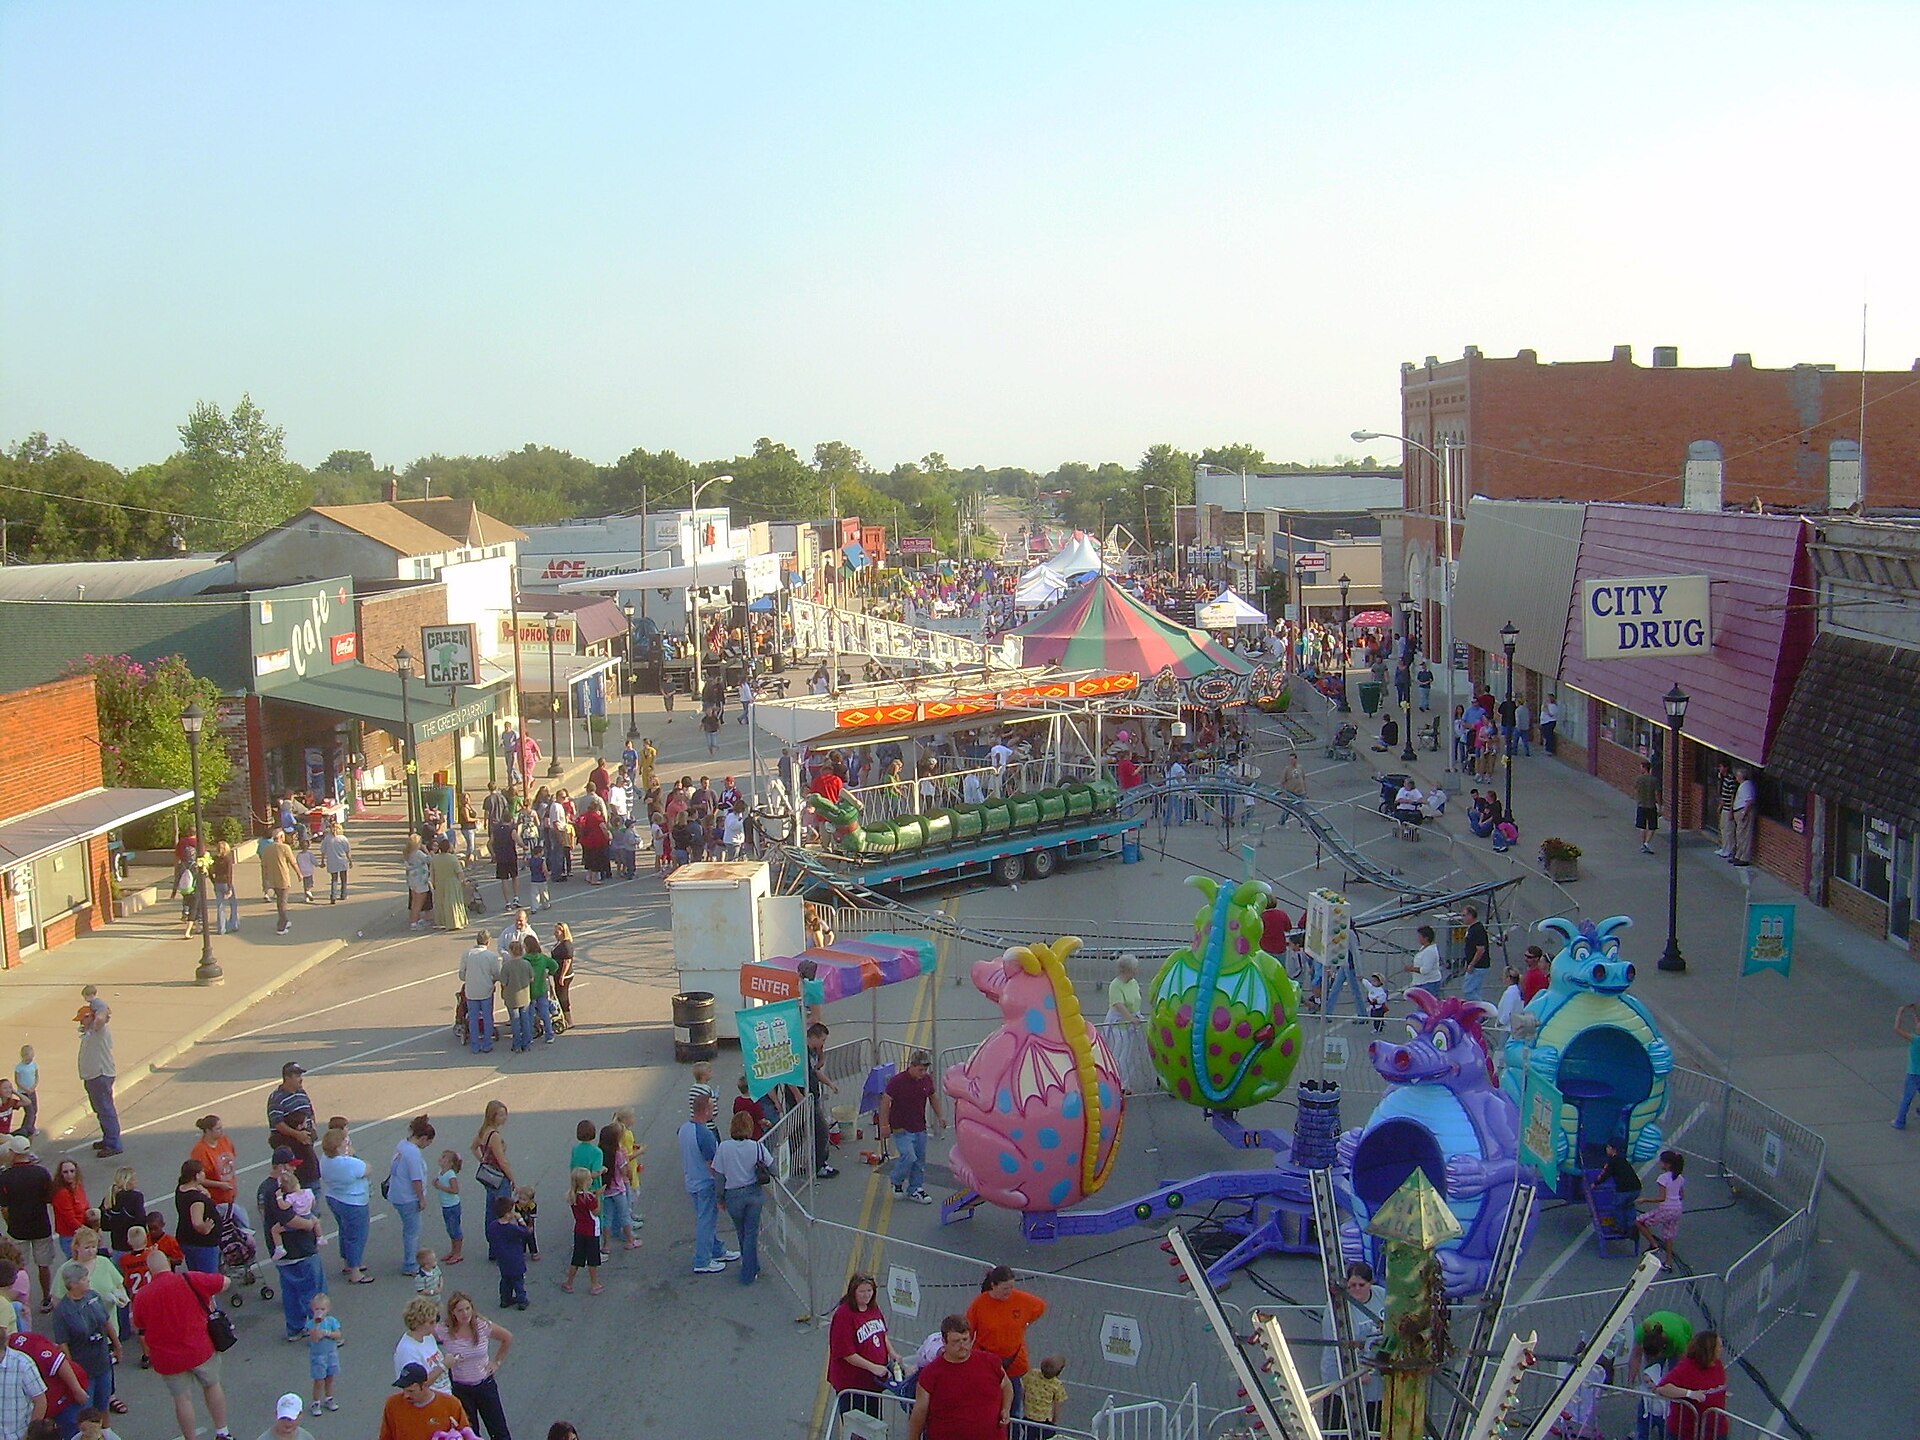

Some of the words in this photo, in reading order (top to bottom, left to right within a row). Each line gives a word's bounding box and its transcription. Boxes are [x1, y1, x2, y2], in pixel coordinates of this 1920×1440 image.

[541, 558, 585, 579] ACE
[1239, 582, 1253, 592] 25
[1592, 585, 1668, 617] CITY
[291, 589, 330, 676] Cafe
[427, 630, 468, 649] GREEN
[1618, 619, 1705, 650] DRUG
[431, 662, 469, 682] CAFE
[422, 720, 437, 738] THE
[437, 712, 461, 732] GREEN
[461, 700, 488, 723] PARROT
[751, 977, 790, 996] ENTER
